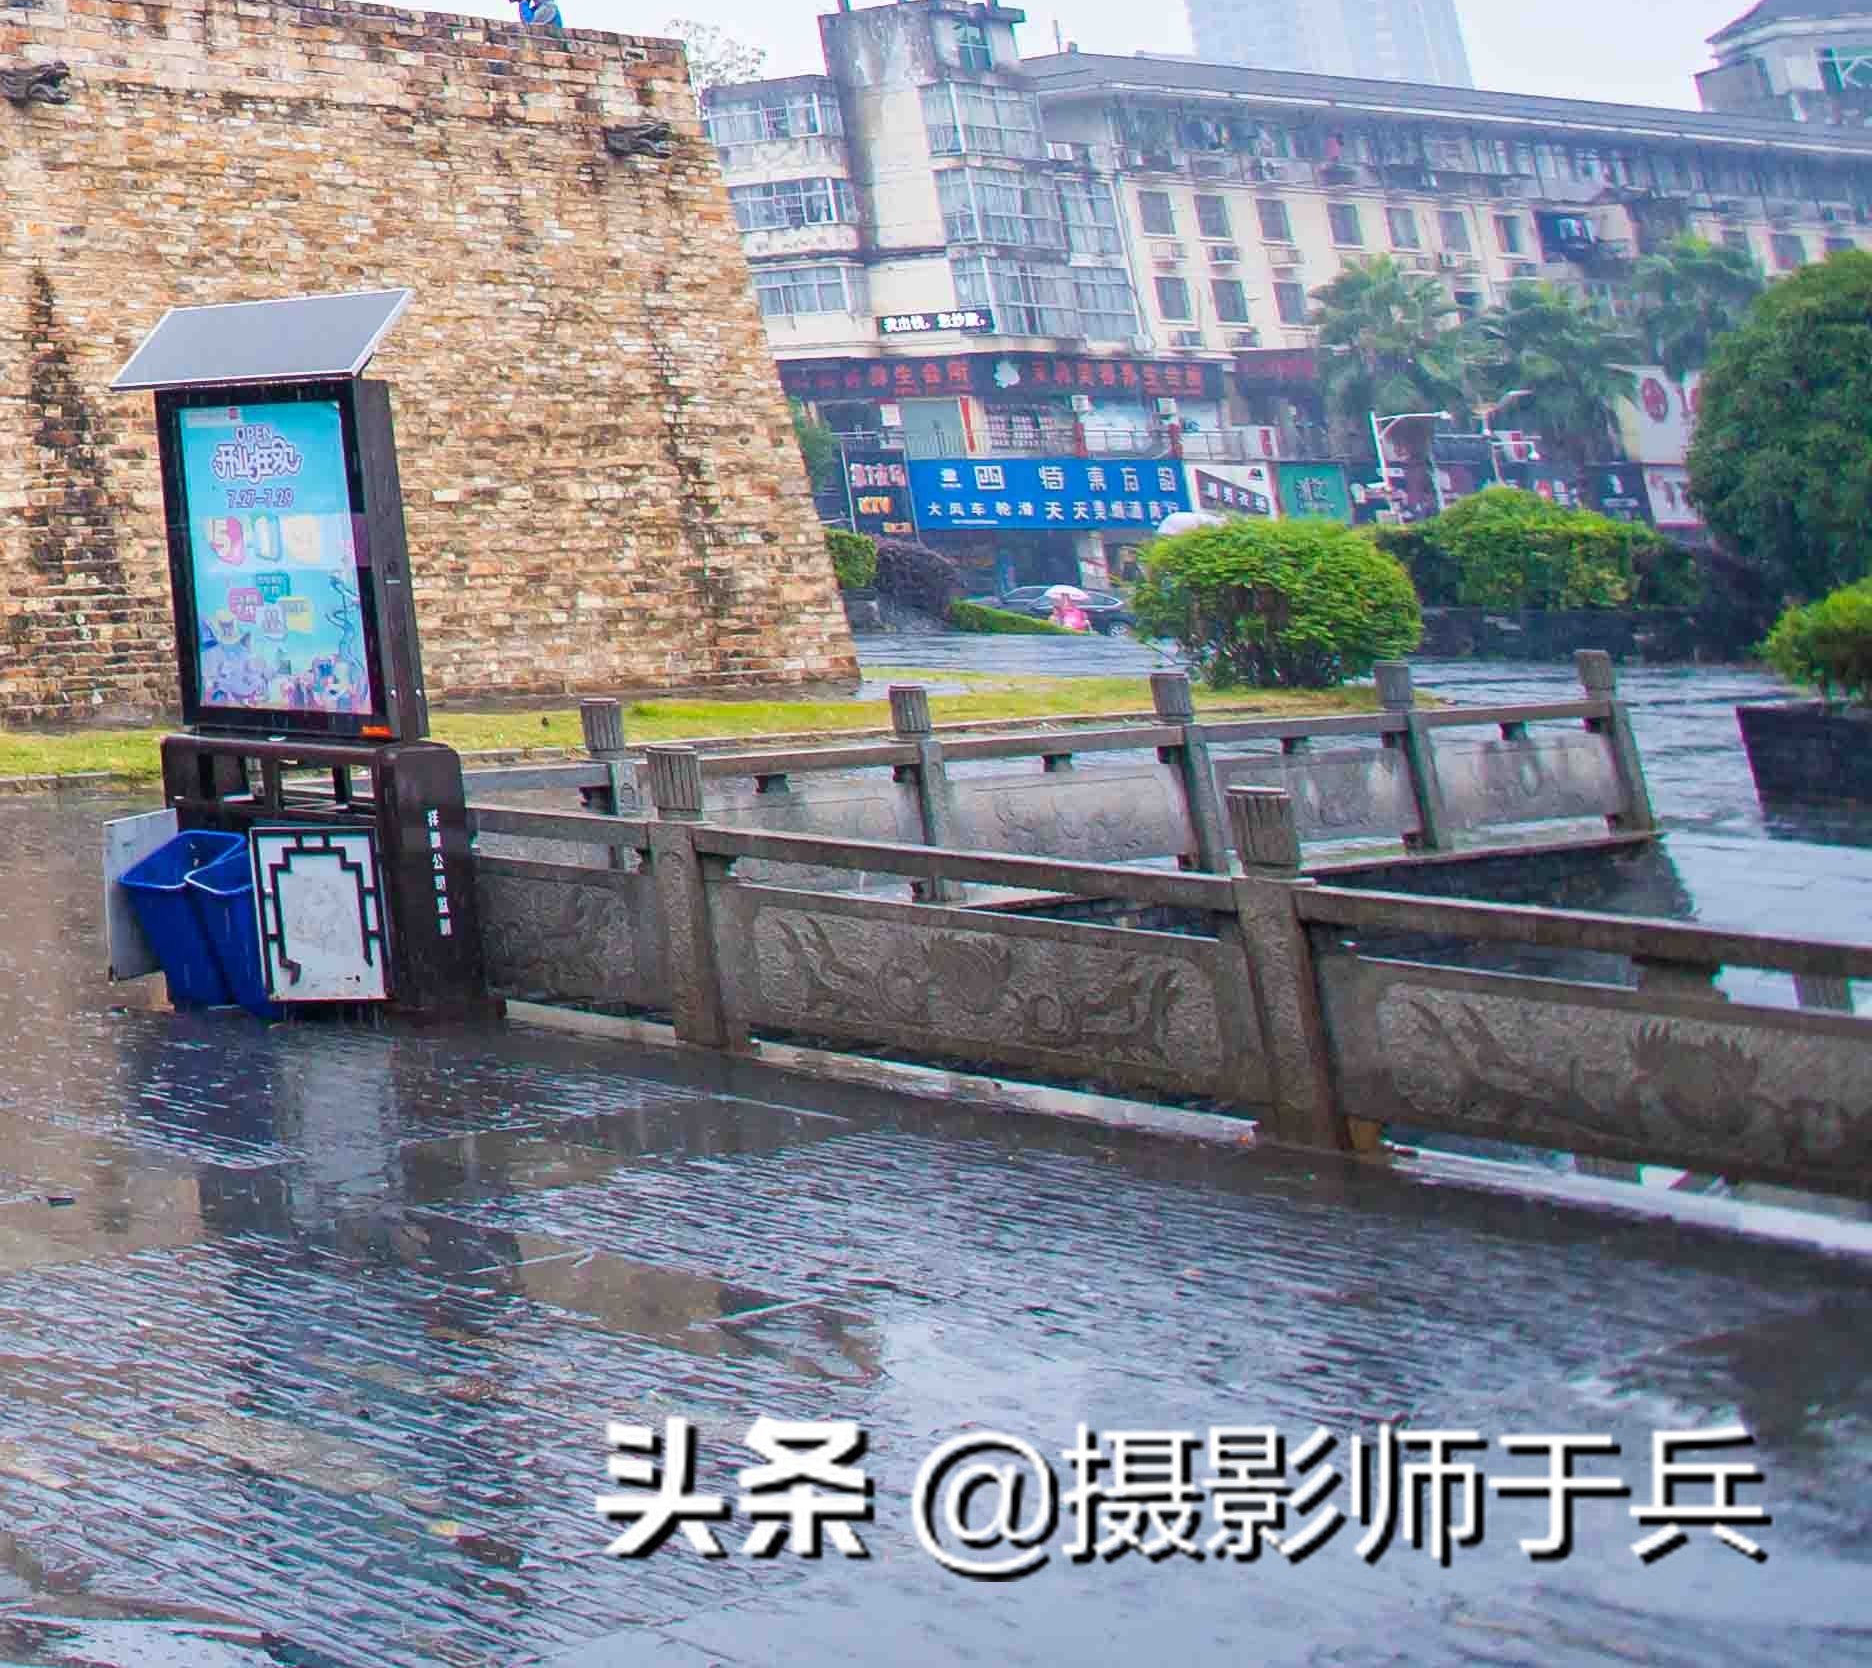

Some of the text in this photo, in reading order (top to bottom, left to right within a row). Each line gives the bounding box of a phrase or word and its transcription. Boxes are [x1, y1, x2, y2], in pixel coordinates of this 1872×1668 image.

[235, 426, 273, 444] OPEN
[213, 437, 302, 484] 开业狂欢
